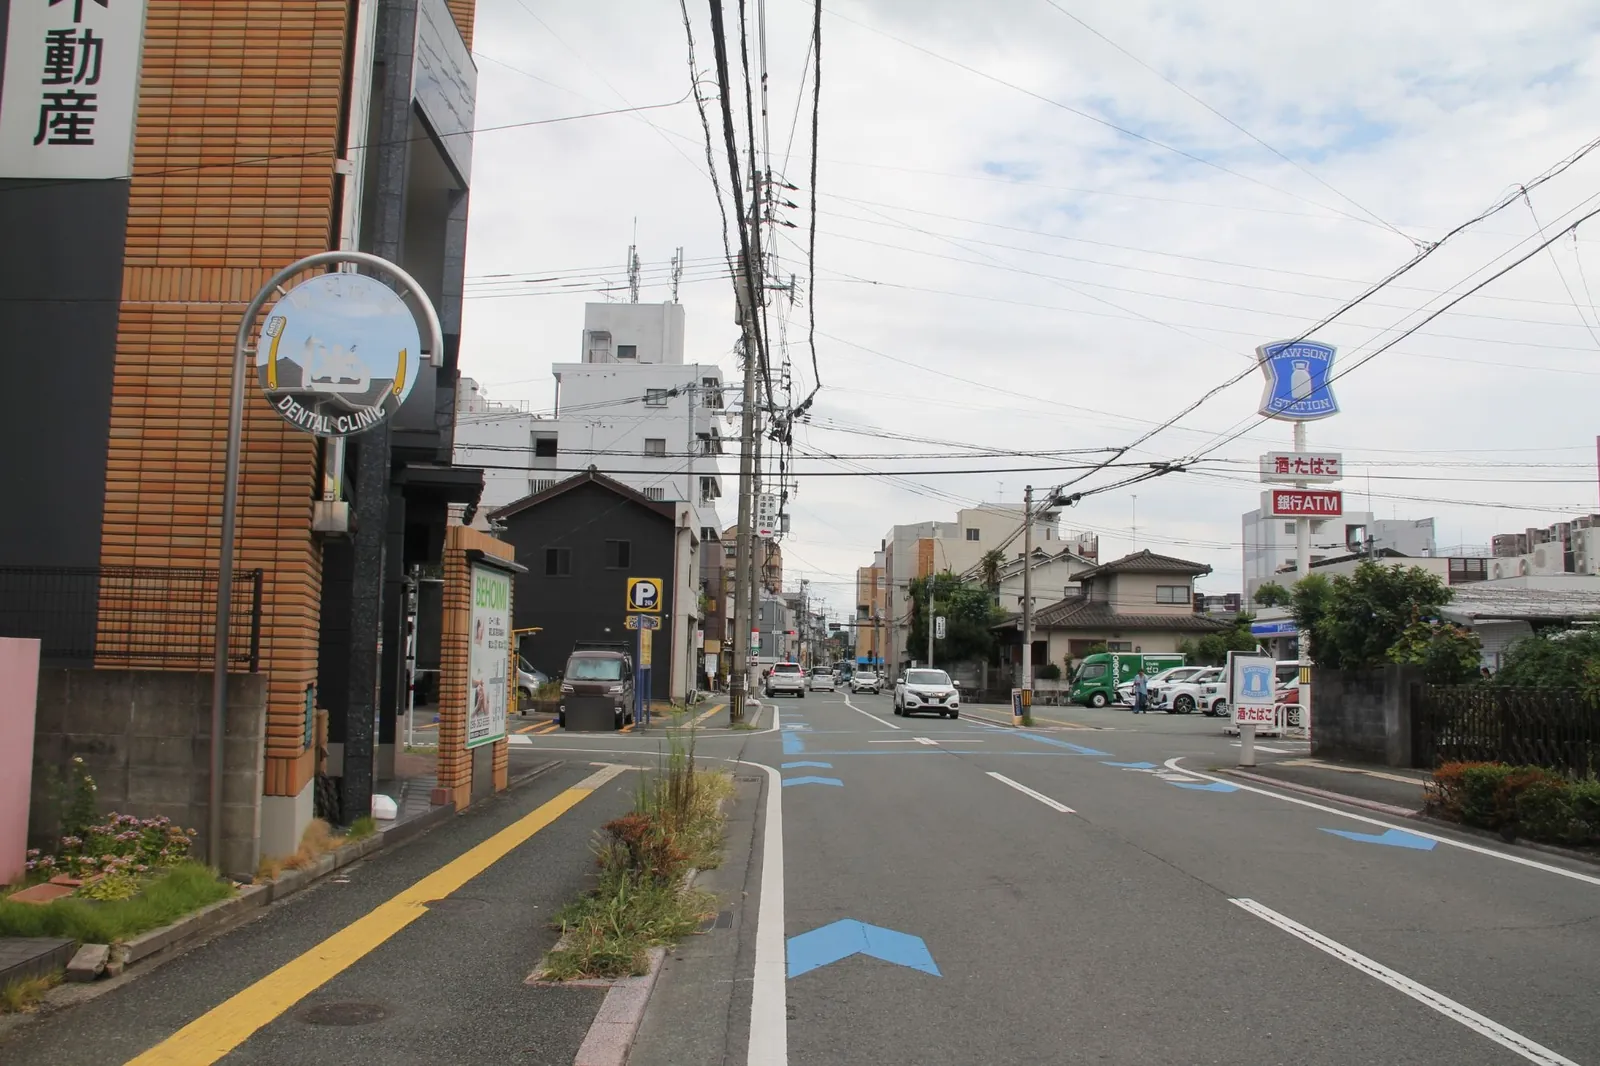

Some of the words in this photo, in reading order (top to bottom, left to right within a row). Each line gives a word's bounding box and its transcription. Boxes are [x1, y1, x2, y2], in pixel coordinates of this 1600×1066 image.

[1271, 347, 1329, 362] LAWSON
[1273, 397, 1330, 411] STATION
[277, 395, 331, 433] DENTAL
[337, 406, 386, 433] CLINIC
[1275, 456, 1338, 475] 酒・たばこ
[1277, 494, 1338, 511] 銀行ATM
[635, 582, 656, 606] P
[1237, 706, 1273, 721] 酒・たばこ
